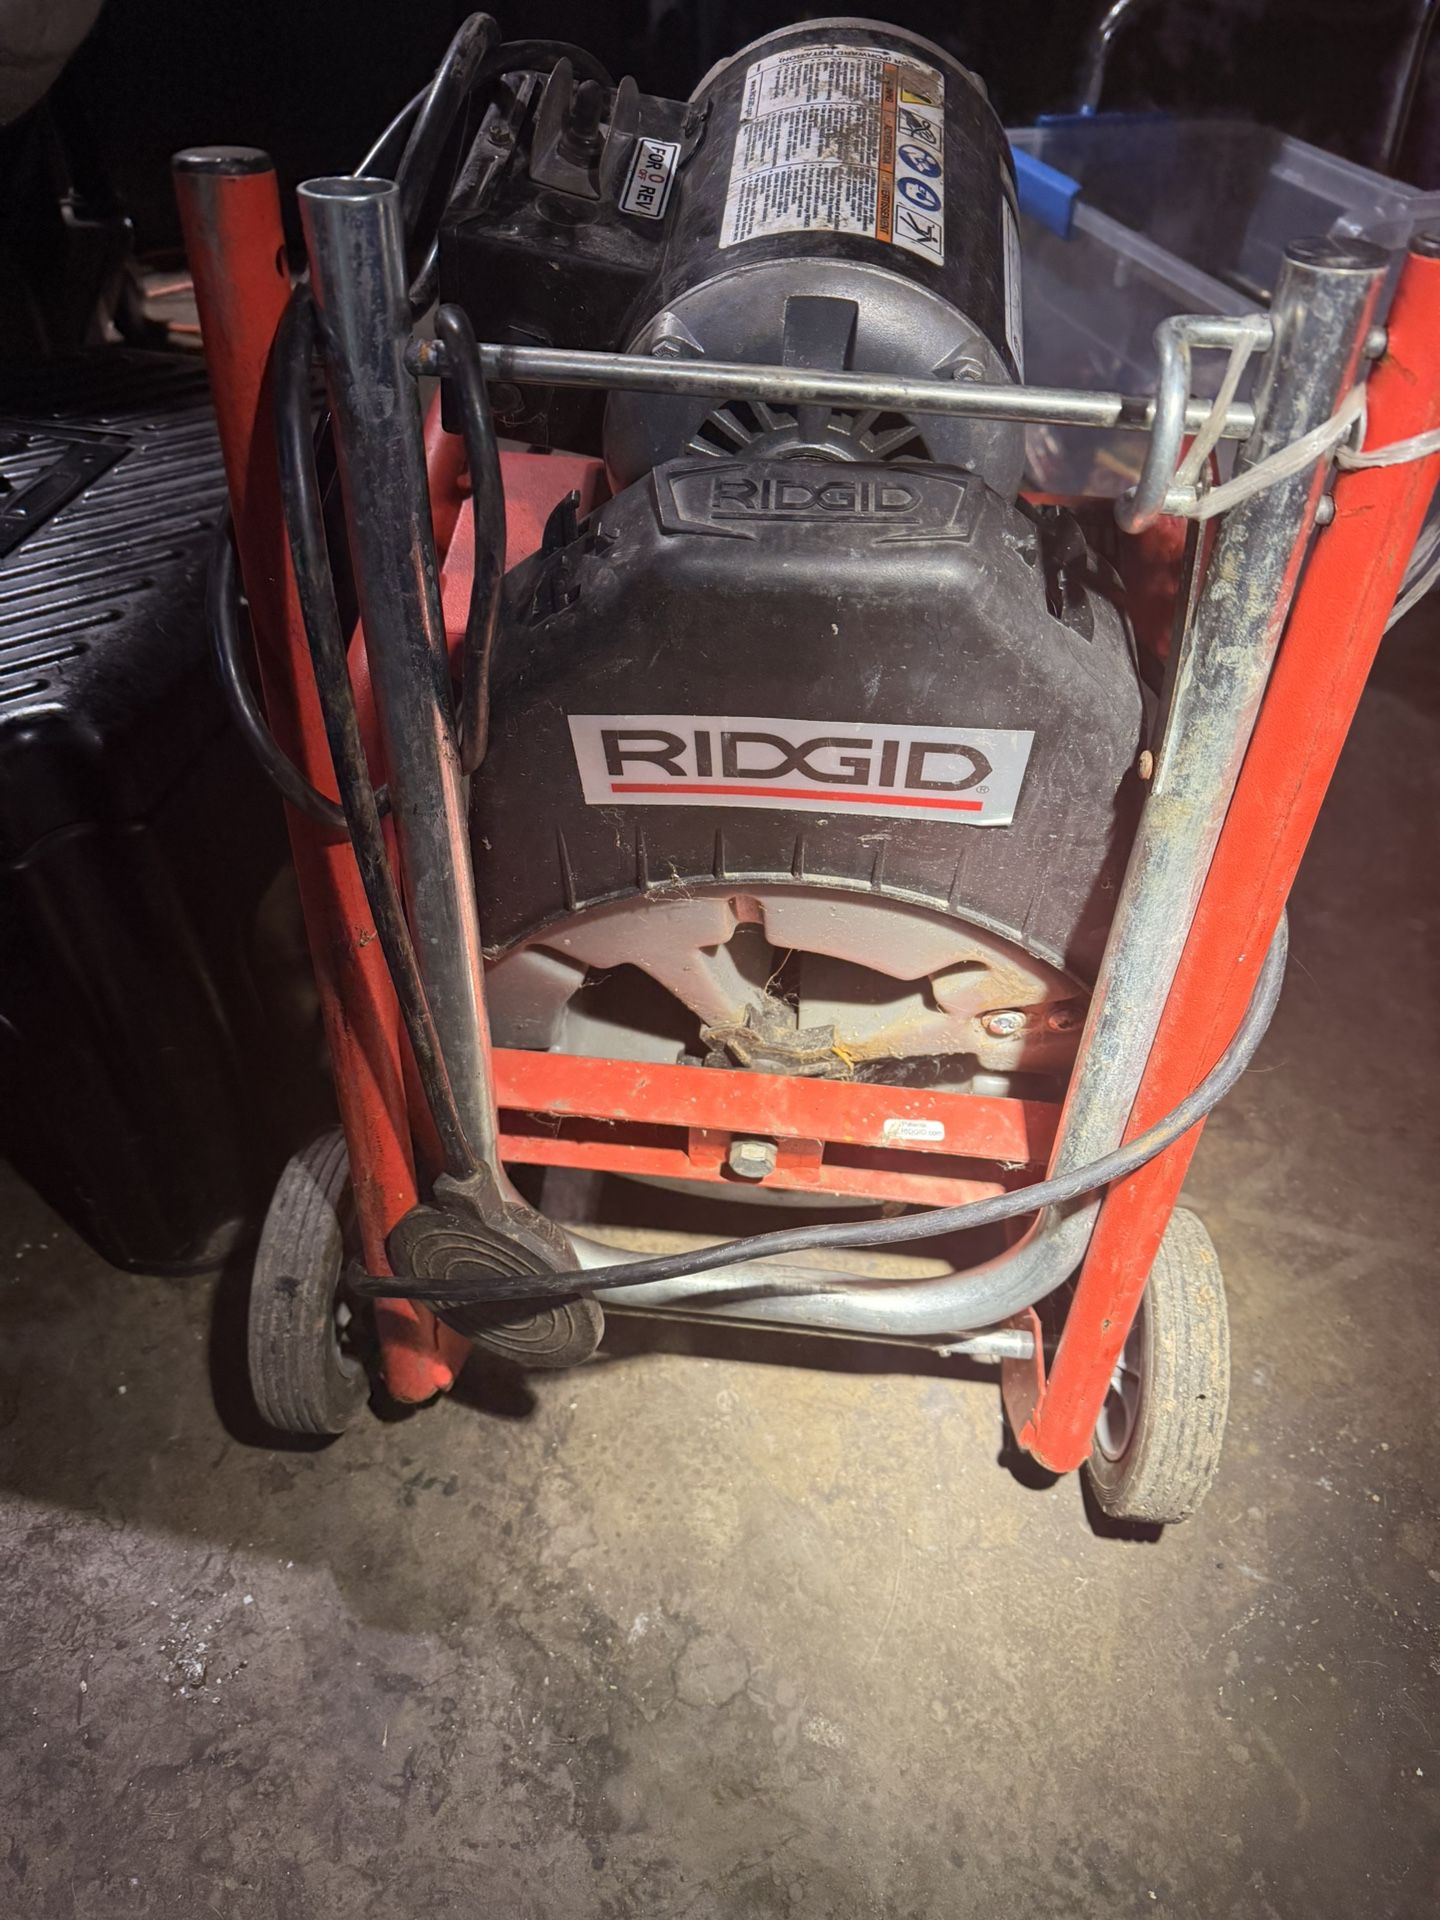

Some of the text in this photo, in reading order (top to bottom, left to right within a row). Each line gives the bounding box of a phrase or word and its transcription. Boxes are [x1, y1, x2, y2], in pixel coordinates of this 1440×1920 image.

[645, 146, 666, 170] FOR
[635, 184, 656, 211] REV
[711, 478, 922, 513] RIDGID
[600, 729, 993, 792] RIDGID
